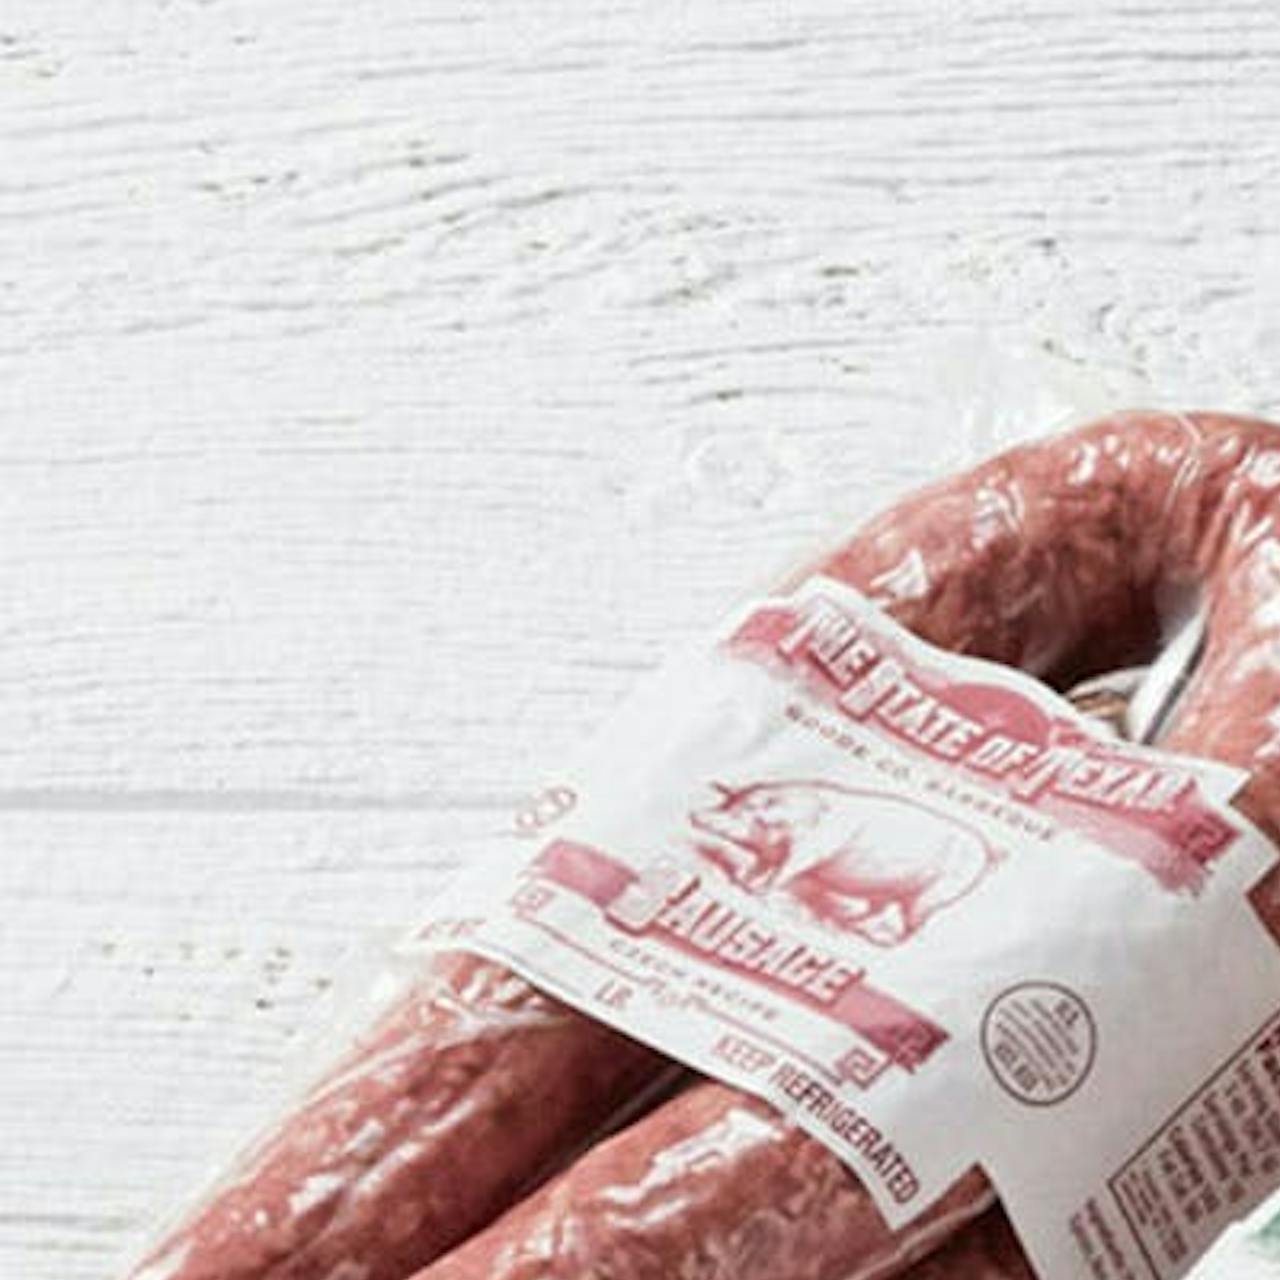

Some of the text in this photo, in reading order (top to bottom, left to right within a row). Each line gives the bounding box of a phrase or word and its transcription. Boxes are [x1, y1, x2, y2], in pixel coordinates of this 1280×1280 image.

[777, 596, 876, 690] THE
[838, 658, 984, 765] STATE
[964, 735, 1040, 780] OF
[713, 1033, 920, 1206] KEEP REFRIGERATED
